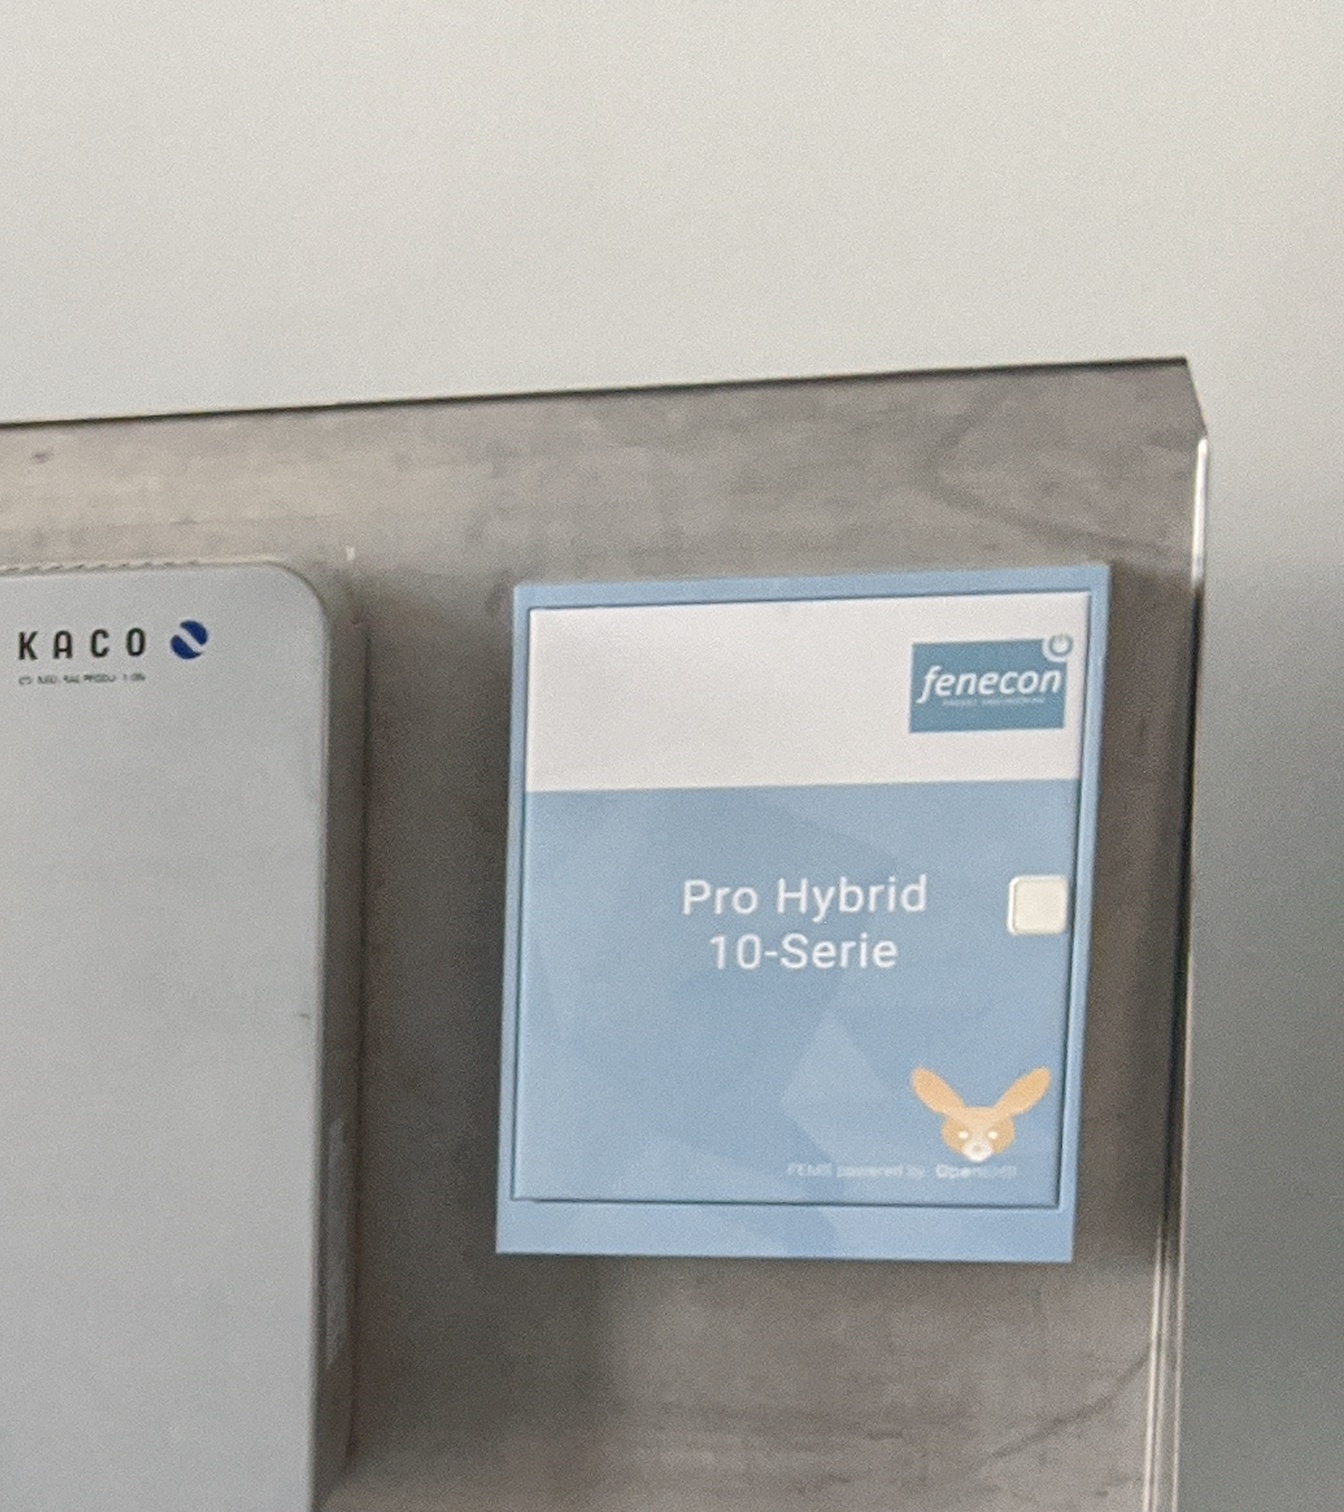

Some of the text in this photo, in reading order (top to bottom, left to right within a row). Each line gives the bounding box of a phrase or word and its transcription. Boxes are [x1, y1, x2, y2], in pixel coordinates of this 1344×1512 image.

[18, 627, 146, 661] KACO
[915, 664, 1062, 704] fenecon
[682, 873, 928, 924] Pro Hybrid
[709, 931, 898, 970] 10-Serie
